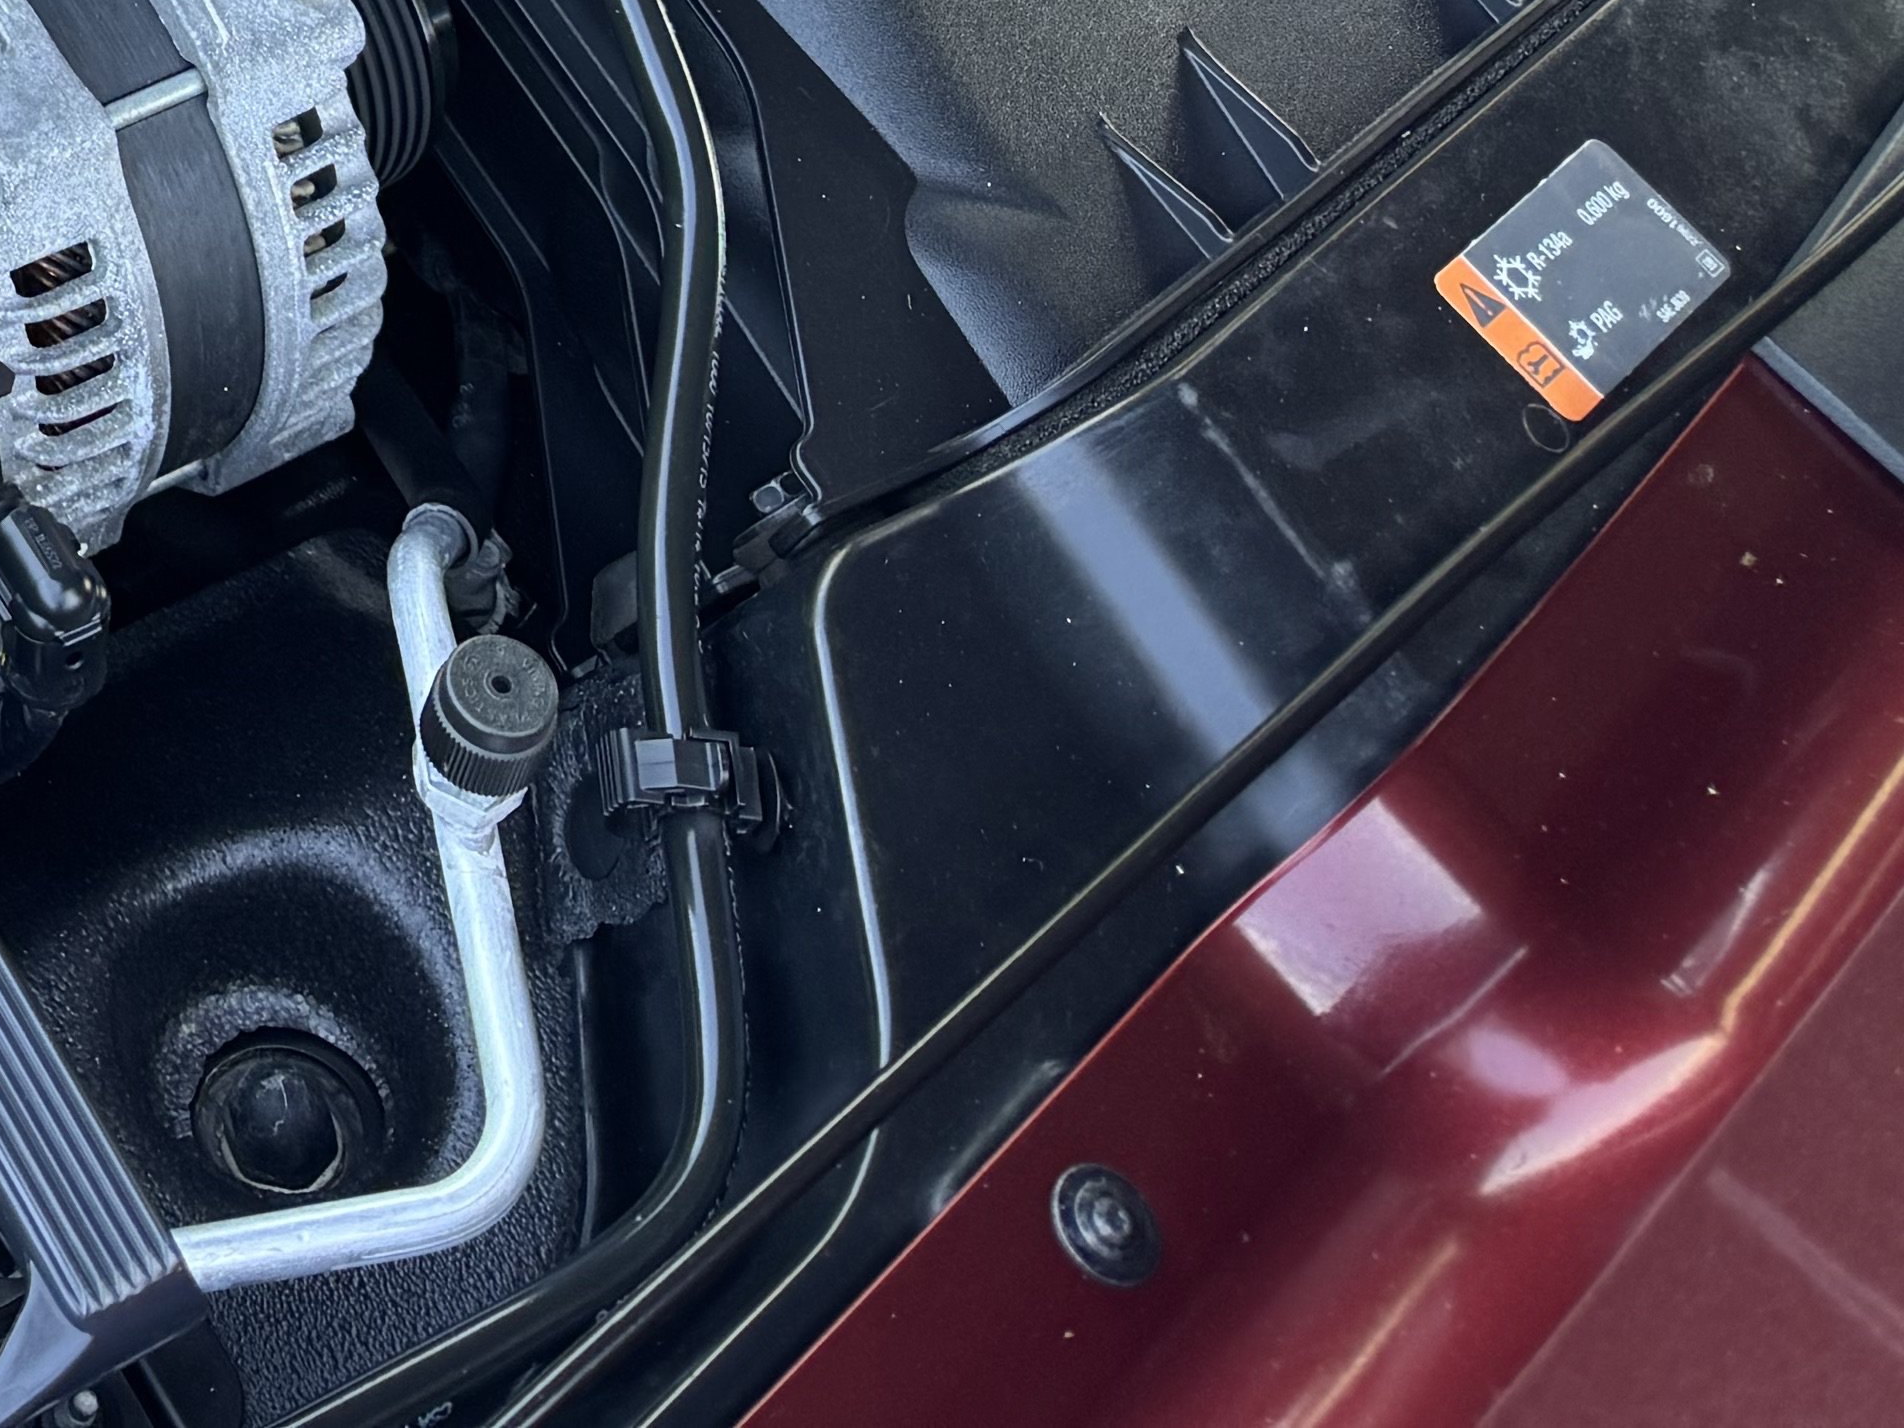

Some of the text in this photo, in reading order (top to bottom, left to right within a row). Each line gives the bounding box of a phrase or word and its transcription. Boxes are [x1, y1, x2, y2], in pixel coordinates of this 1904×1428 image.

[1527, 180, 1631, 270] R-134a 0.600 kg
[1590, 300, 1624, 335] PAG
